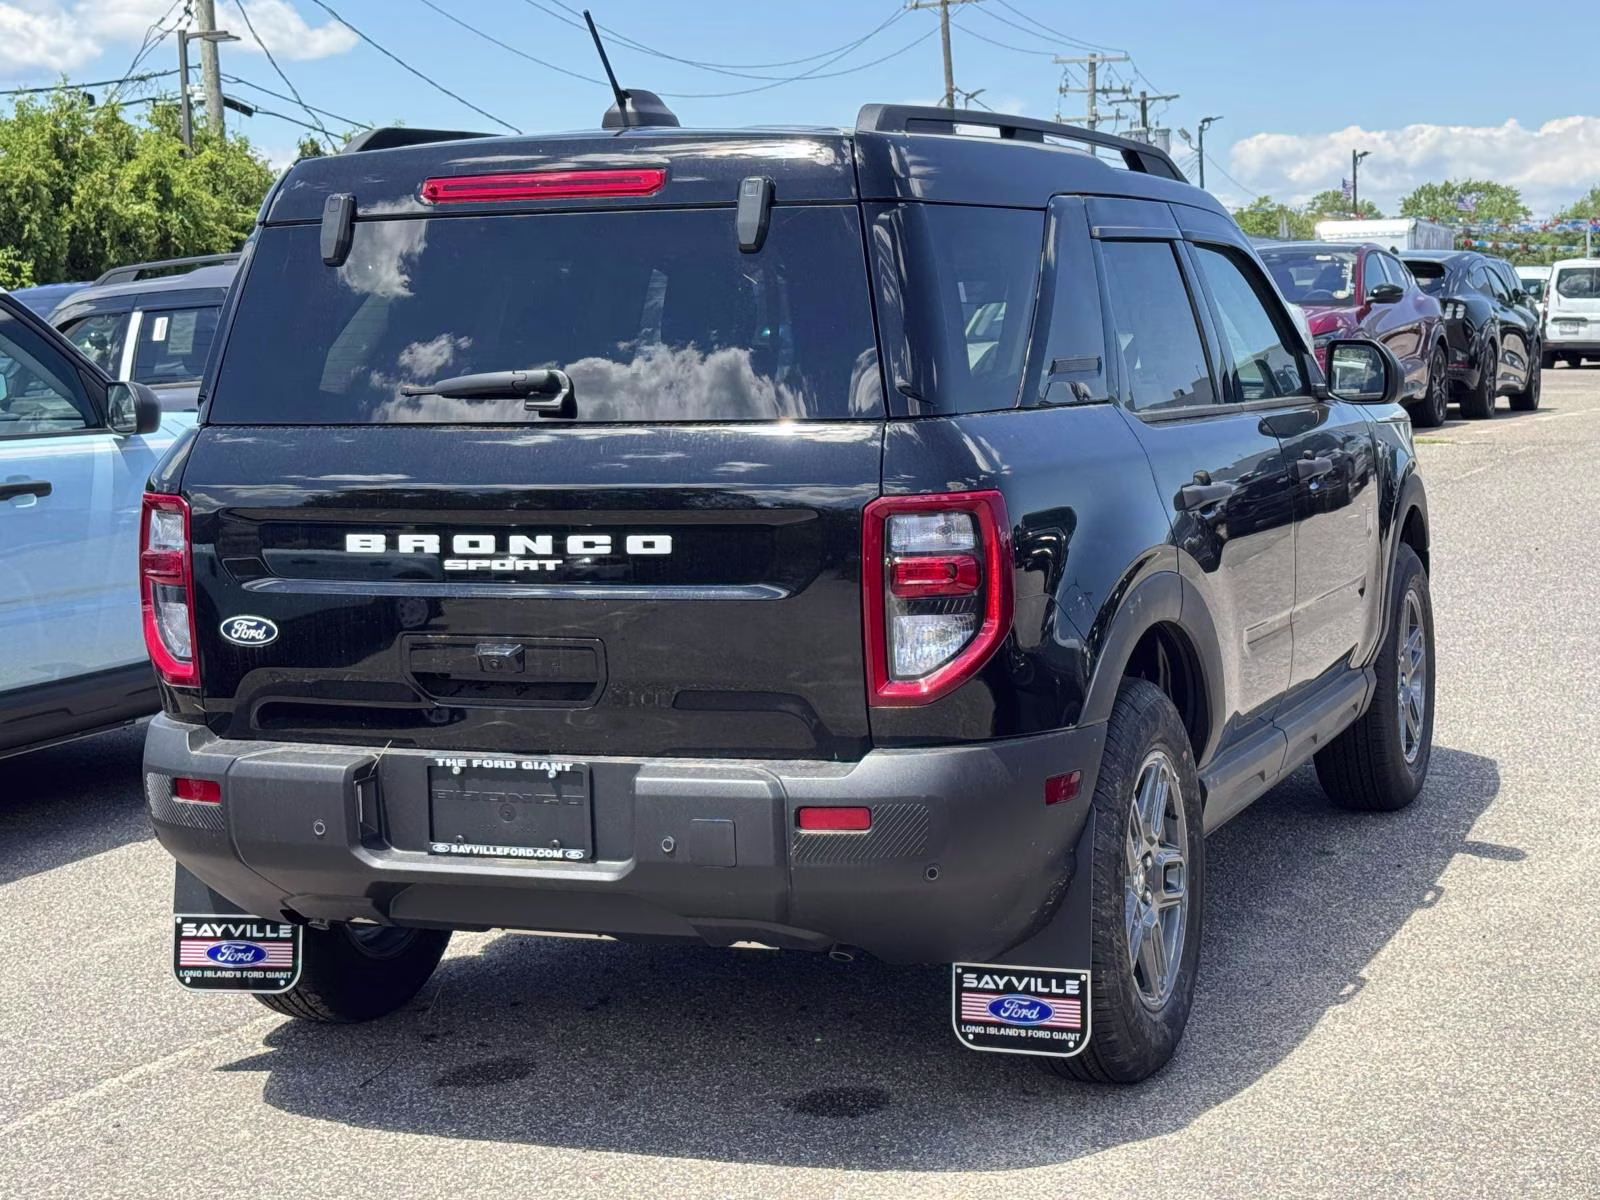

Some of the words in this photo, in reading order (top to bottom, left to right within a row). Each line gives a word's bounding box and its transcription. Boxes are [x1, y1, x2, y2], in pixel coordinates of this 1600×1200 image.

[345, 533, 673, 555] BRONCO
[443, 558, 563, 571] SPORT
[231, 620, 266, 639] Ford
[435, 758, 467, 768] THE
[472, 759, 517, 769] FORD
[522, 761, 573, 772] GIANT
[450, 844, 563, 858] SAYVILLEFORD.COM
[181, 922, 293, 938] SAYVILLE
[217, 944, 255, 962] Ford
[180, 970, 202, 978] LONG
[204, 970, 241, 978] ISLAND'S
[243, 970, 265, 978] FORD
[266, 971, 293, 979] GIANT
[962, 973, 1080, 995] SAYVILLE
[1000, 999, 1040, 1019] Ford
[961, 1024, 985, 1034] LONG
[986, 1026, 1026, 1037] ISLAND'S
[1027, 1029, 1051, 1039] FORD
[1052, 1032, 1081, 1042] GIANT
